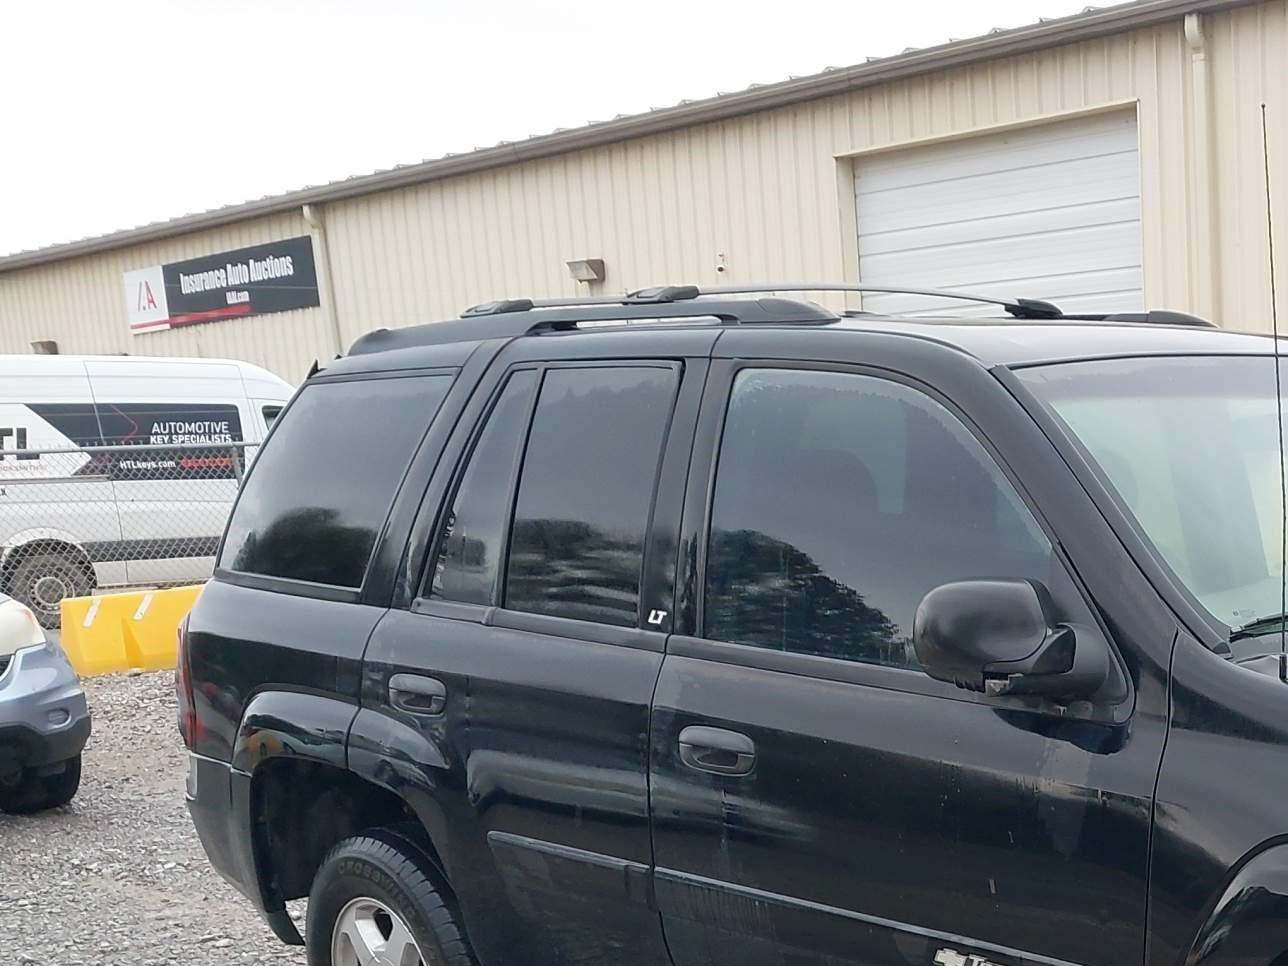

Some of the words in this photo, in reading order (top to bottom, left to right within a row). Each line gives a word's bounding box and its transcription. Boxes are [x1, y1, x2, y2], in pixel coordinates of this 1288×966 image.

[179, 268, 227, 295] Insurance
[226, 262, 250, 287] Auto
[249, 255, 294, 283] Auctions
[151, 421, 229, 434] AUTOMOTIVE
[150, 435, 169, 445] KEY
[171, 434, 232, 444] SPECIALISTS
[120, 460, 176, 470] HTLkeys.com
[647, 609, 668, 625] LT
